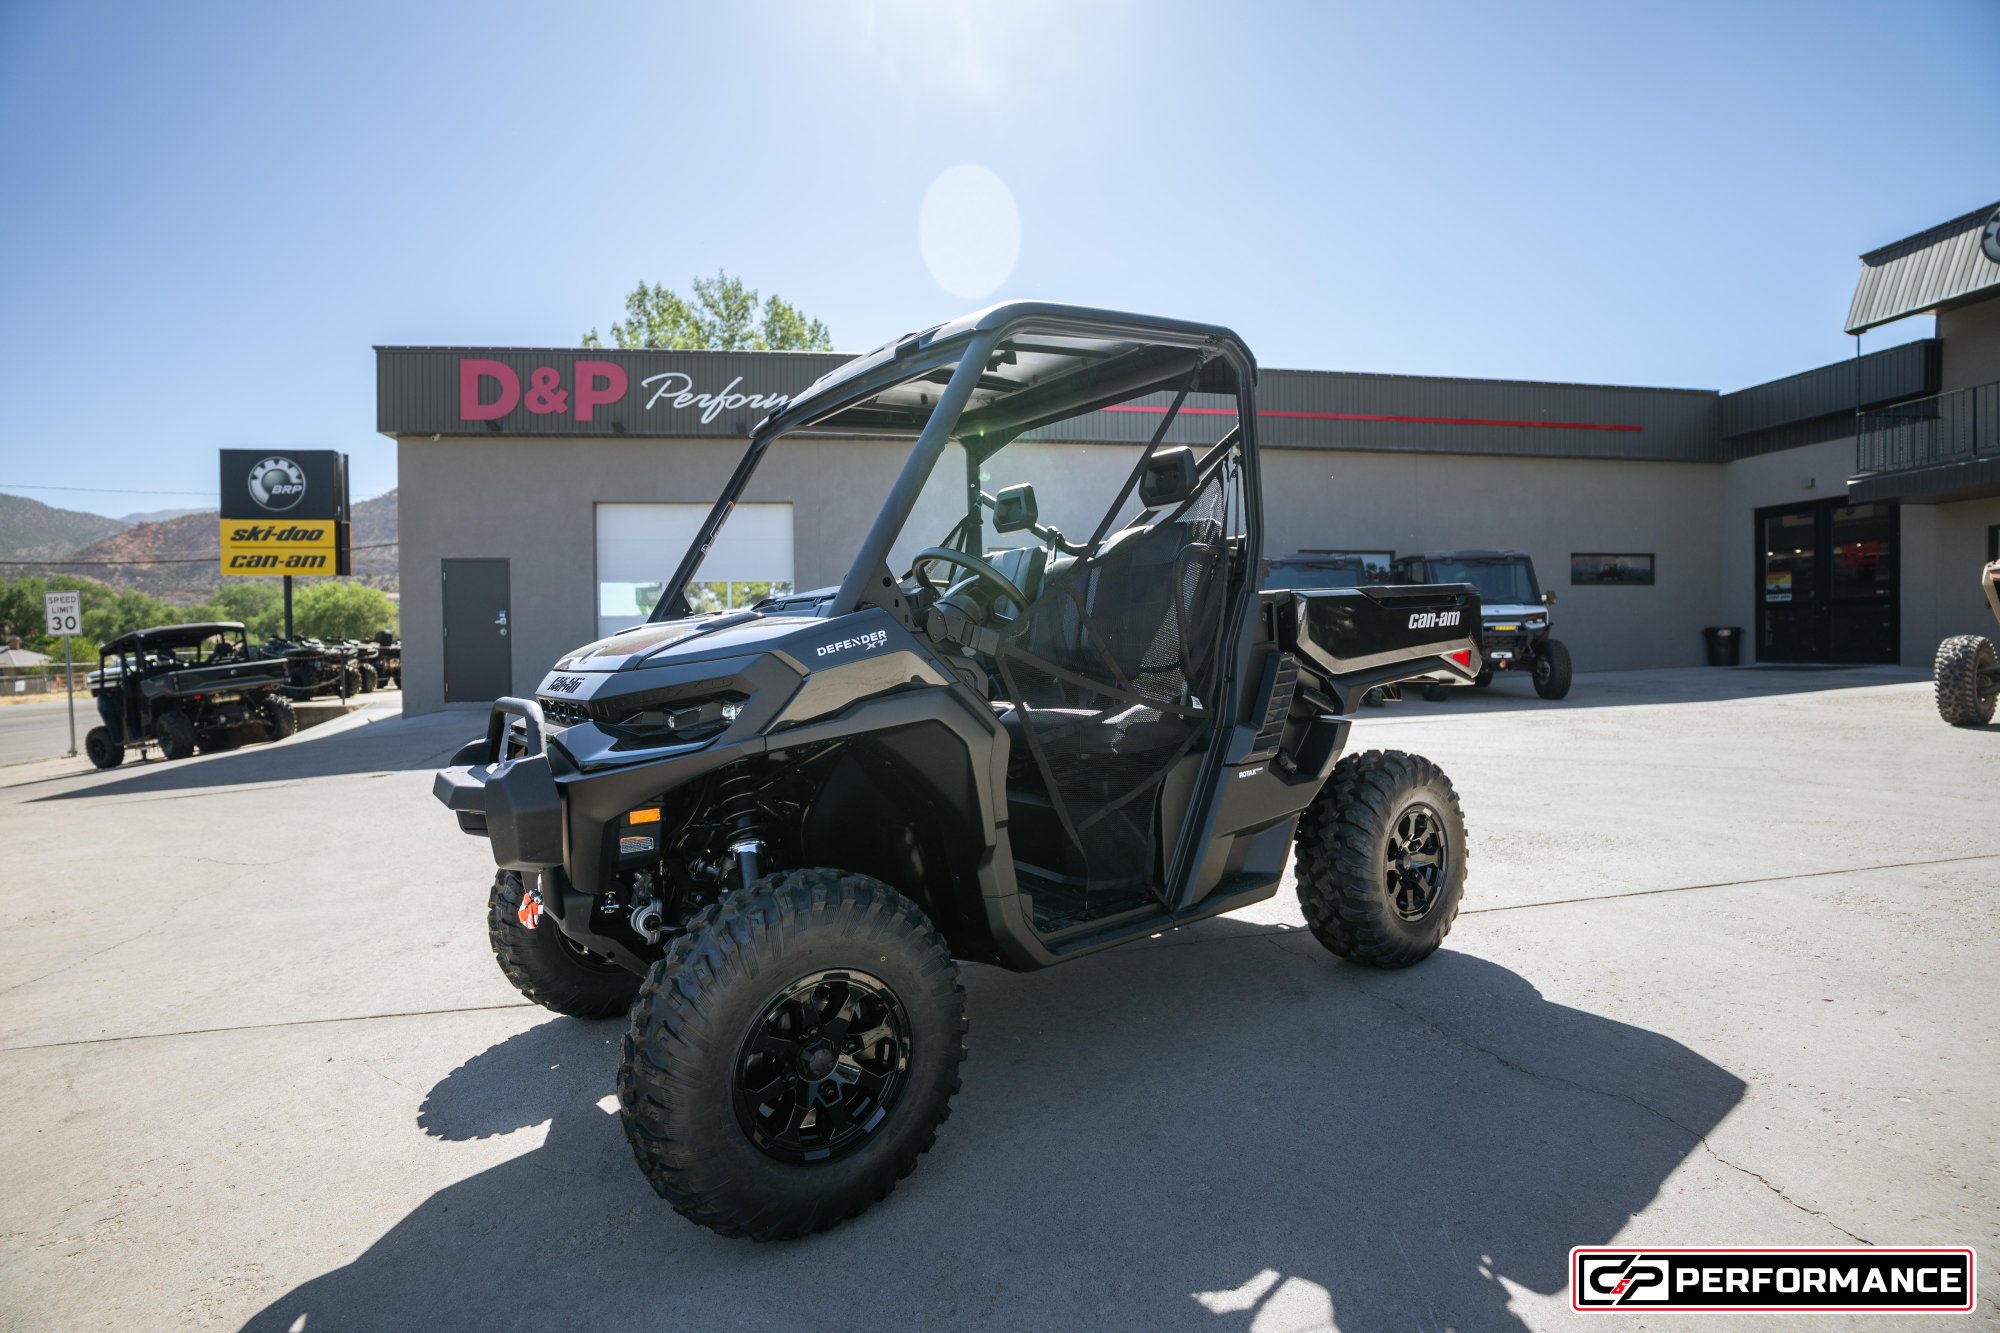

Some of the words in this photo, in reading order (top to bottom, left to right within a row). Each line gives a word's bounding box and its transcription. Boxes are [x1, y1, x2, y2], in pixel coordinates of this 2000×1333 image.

[460, 359, 628, 421] D&P
[271, 485, 303, 495] BRP
[230, 526, 324, 541] ski-doo
[229, 555, 326, 568] can-am
[48, 596, 76, 604] SPEED
[52, 606, 73, 614] LIMIT
[52, 616, 76, 630] 30
[1408, 611, 1460, 629] can-am
[816, 630, 887, 656] DEFENDER
[866, 639, 887, 650] XT
[1238, 769, 1256, 779] ROTAX
